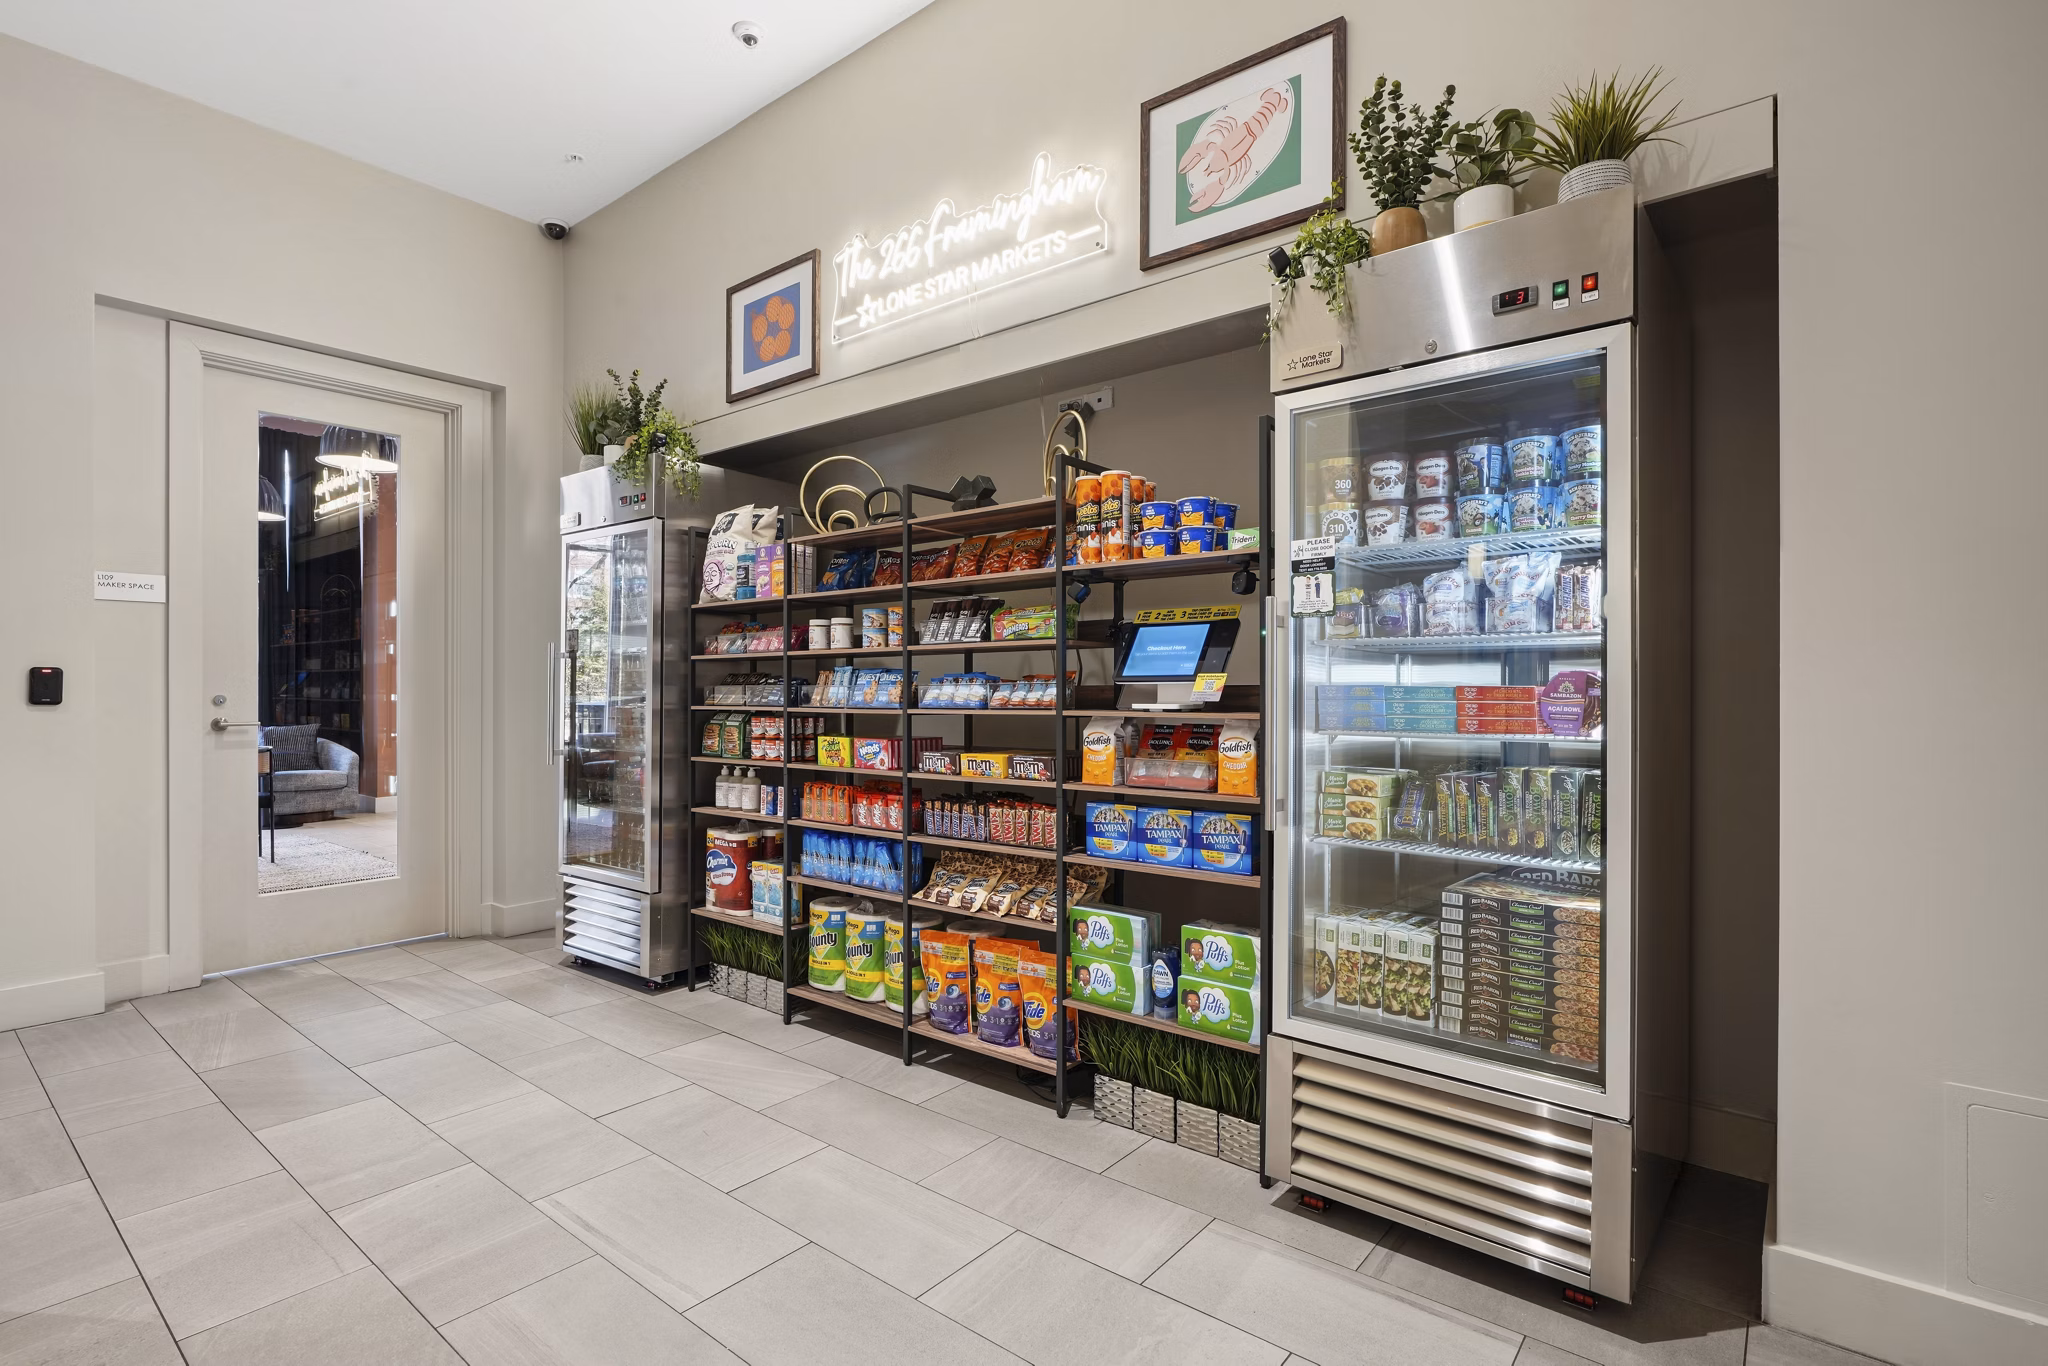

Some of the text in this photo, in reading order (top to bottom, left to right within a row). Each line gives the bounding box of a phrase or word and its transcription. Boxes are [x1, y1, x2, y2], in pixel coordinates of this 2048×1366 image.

[835, 156, 1101, 297] The 266 Framingham
[876, 229, 1067, 317] LONE STAR MARKETS
[1516, 291, 1524, 304] 3
[1300, 350, 1334, 363] Lone Star
[1301, 357, 1331, 369] Markets
[1334, 479, 1351, 489] 360
[1328, 524, 1345, 534] 310
[1231, 535, 1257, 544] Trident
[1307, 538, 1331, 546] PLEASE
[97, 581, 155, 591] MAKER SPACE
[1562, 575, 1572, 609] SNICKERS
[1580, 575, 1590, 608] SNICKERS
[1154, 612, 1162, 620] 2
[1003, 621, 1029, 638] AIRHEADS
[859, 673, 880, 681] QUEST
[1547, 705, 1563, 713] AÇAÍ
[1083, 734, 1111, 748] Goldfish
[1219, 741, 1252, 754] Goldfish
[1222, 761, 1248, 769] CHEDDAR
[1503, 784, 1514, 825] BOWLS
[1530, 785, 1541, 825] BOWLS
[1560, 791, 1570, 827] BOWLS
[1438, 793, 1447, 837] ENCHILADA
[1456, 794, 1466, 839] ENCHILADA
[1478, 795, 1486, 841] ENCHILADA
[990, 810, 1000, 842] TWIX
[1003, 809, 1014, 843] TWIX
[1015, 810, 1026, 844] TWIX
[1031, 810, 1042, 846] TWIX
[1045, 813, 1057, 848] TWIX
[1094, 823, 1127, 833] TAMPAX
[1145, 829, 1182, 839] TAMPAX
[1201, 835, 1240, 845] TAMPAX
[714, 839, 728, 847] MEGA
[706, 856, 729, 868] Charmin
[1481, 898, 1498, 908] BARON
[1482, 913, 1499, 923] BARON
[1090, 920, 1110, 940] Puffs
[1206, 940, 1229, 963] Puffs
[1092, 967, 1112, 988] Puffs
[1024, 1001, 1045, 1019] Tide
[1202, 992, 1226, 1015] Puffs
[1480, 999, 1497, 1009] BARON
[1481, 1013, 1498, 1023] BARON
[1479, 1026, 1496, 1036] BARON
